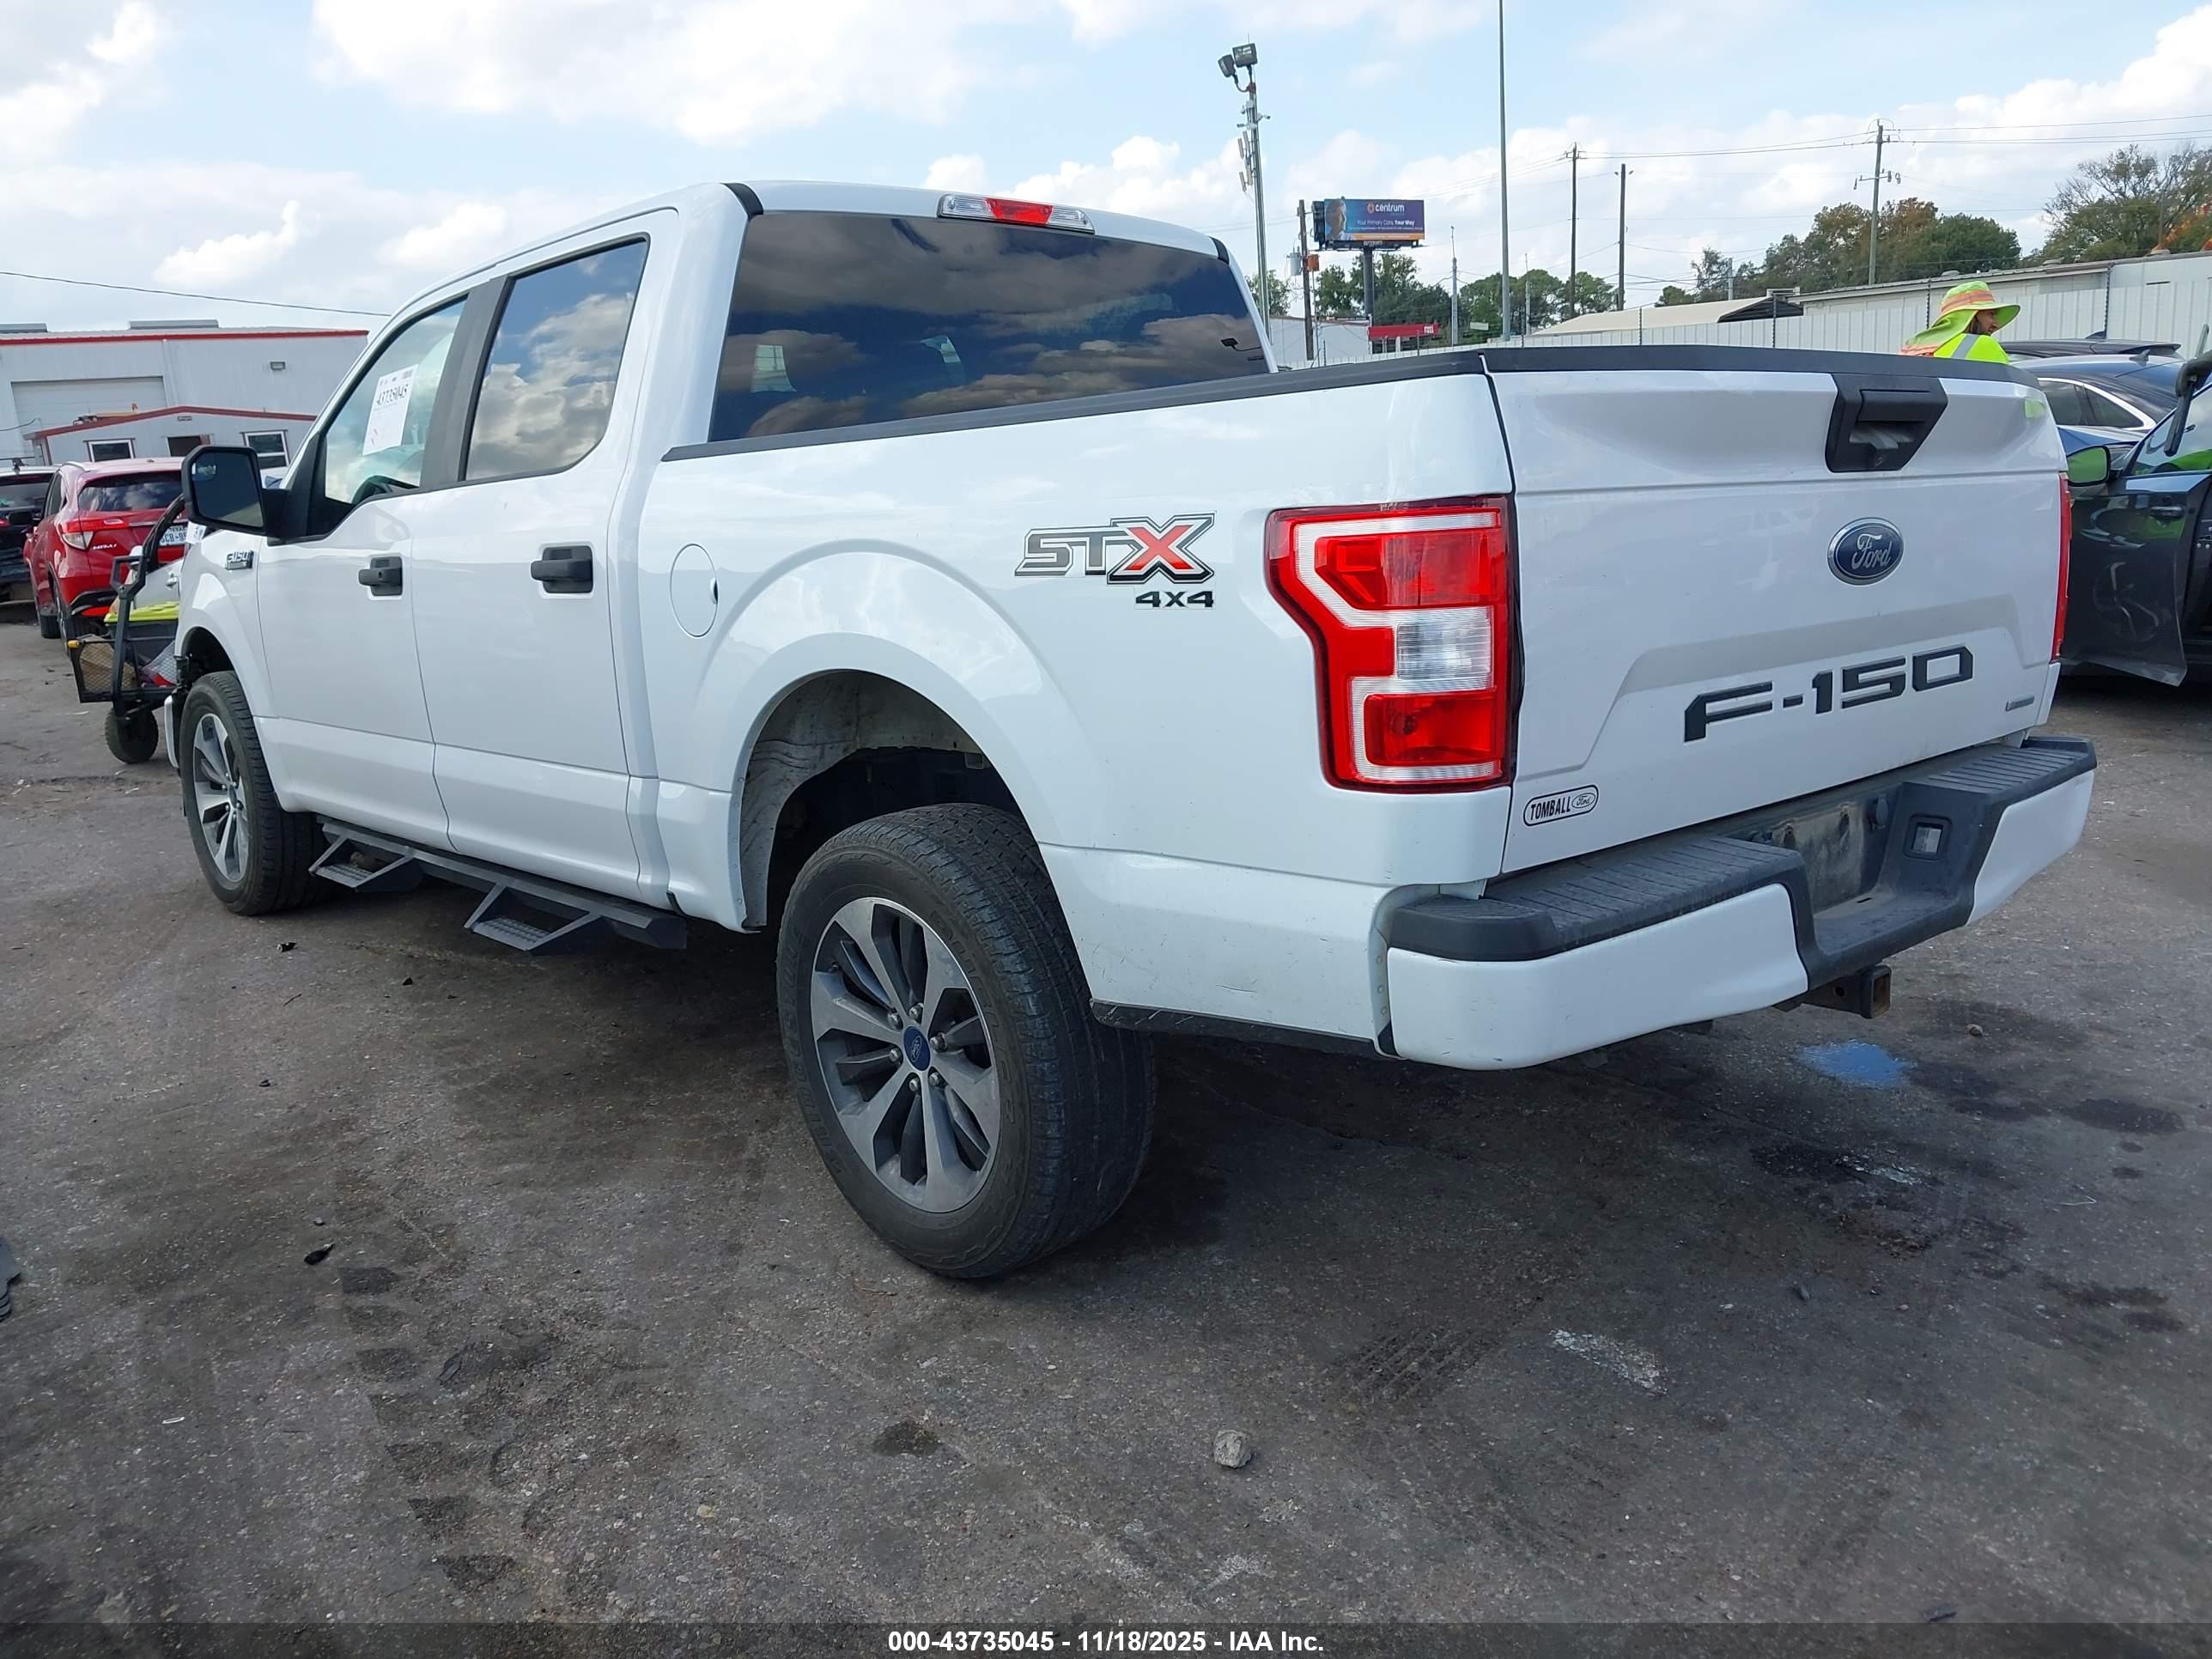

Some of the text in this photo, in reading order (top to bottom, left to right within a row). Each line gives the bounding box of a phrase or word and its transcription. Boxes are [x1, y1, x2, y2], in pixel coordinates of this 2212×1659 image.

[1375, 203, 1405, 212] centrum
[1014, 513, 1215, 585] STX
[1850, 532, 1893, 571] Ford
[1684, 644, 1974, 743] F-150
[1530, 794, 1593, 821] TOMBALL Ford
